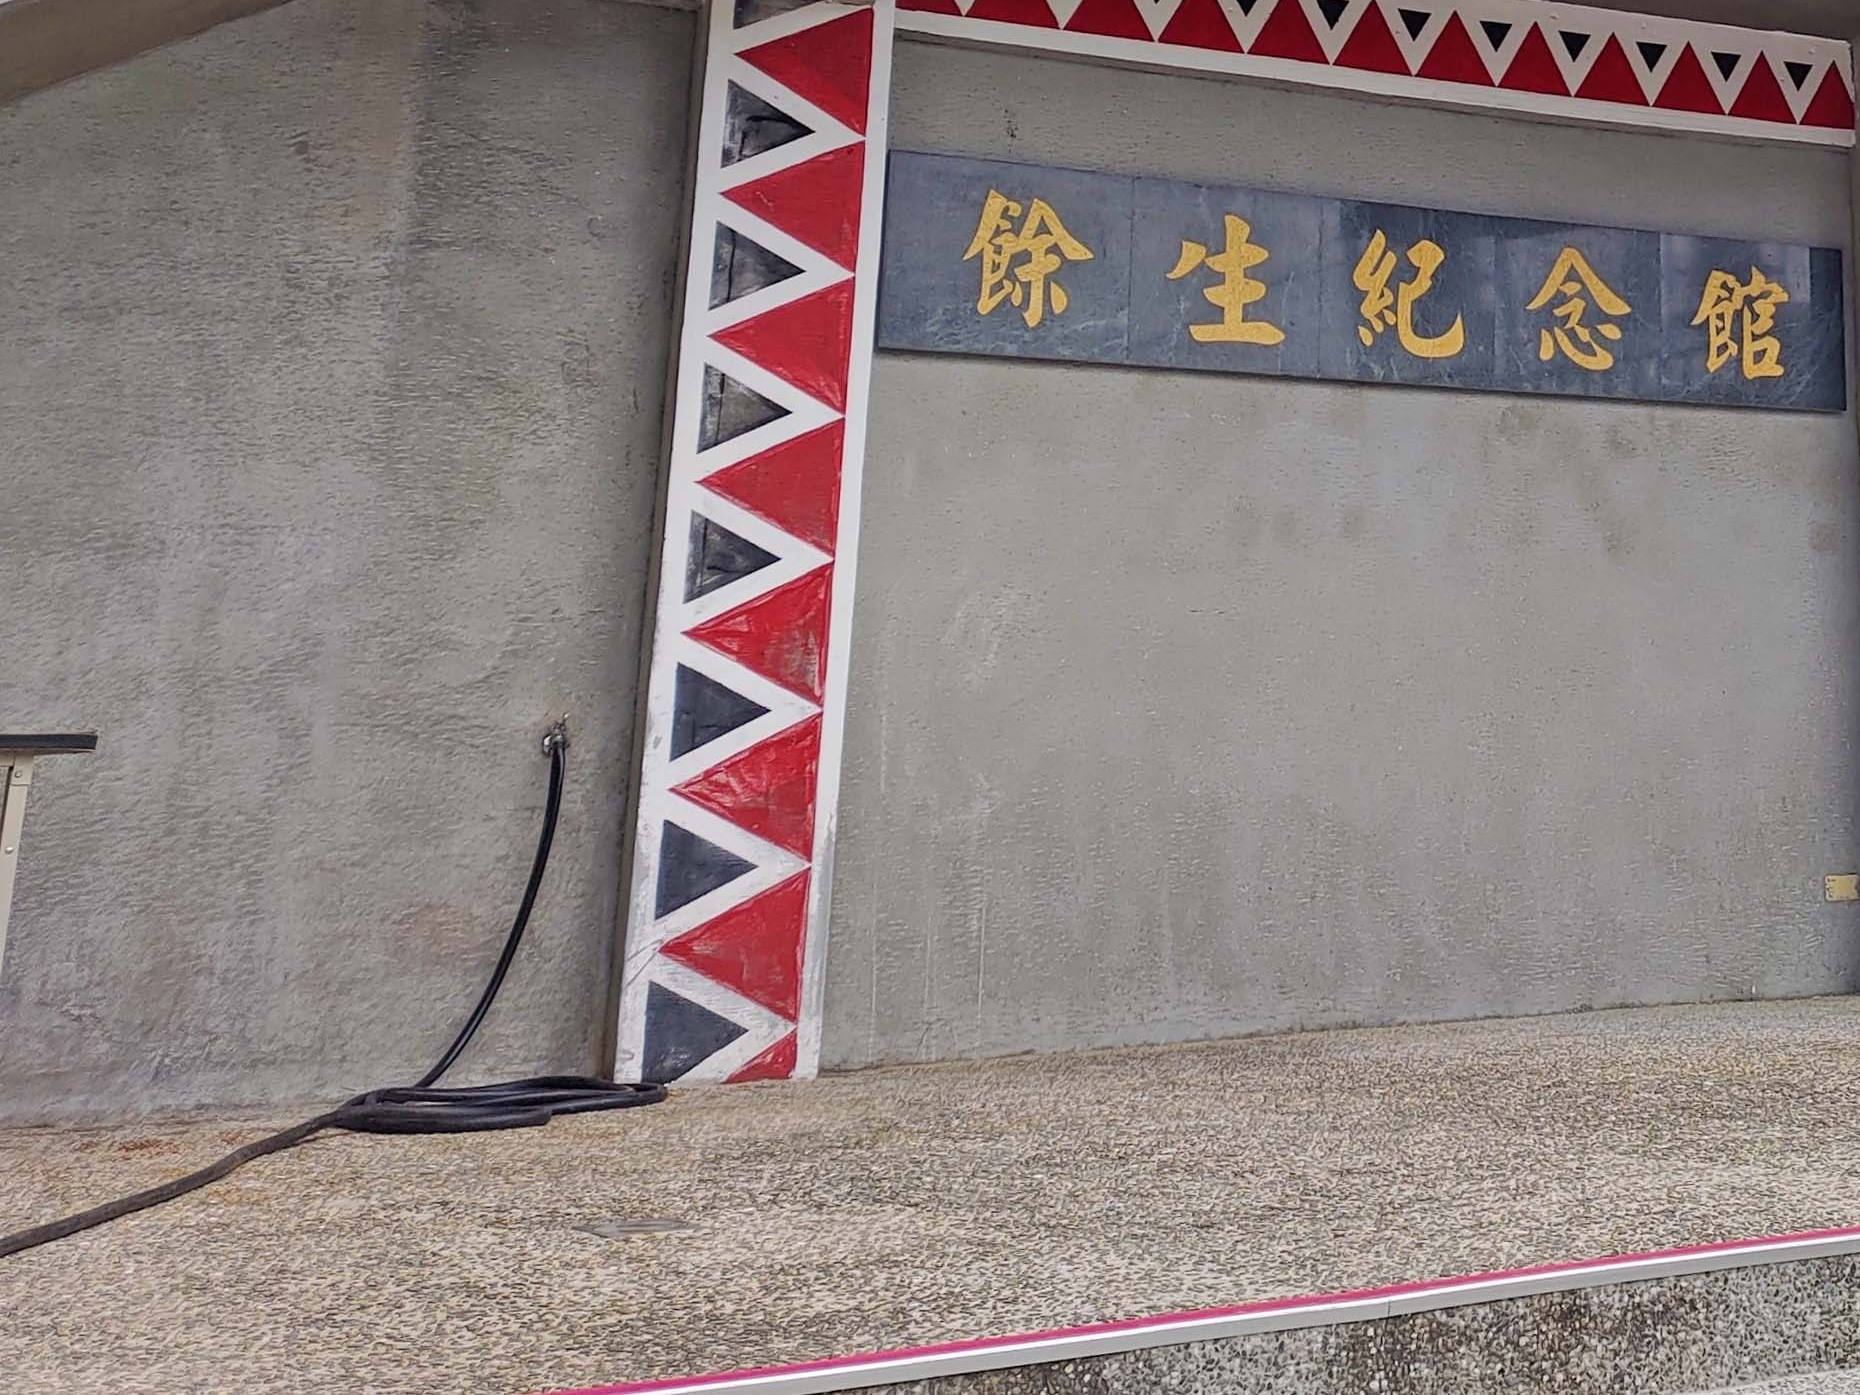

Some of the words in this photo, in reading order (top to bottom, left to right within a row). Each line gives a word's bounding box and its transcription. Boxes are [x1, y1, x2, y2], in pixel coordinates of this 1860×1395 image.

[962, 188, 1789, 380] 餘生紀念館
